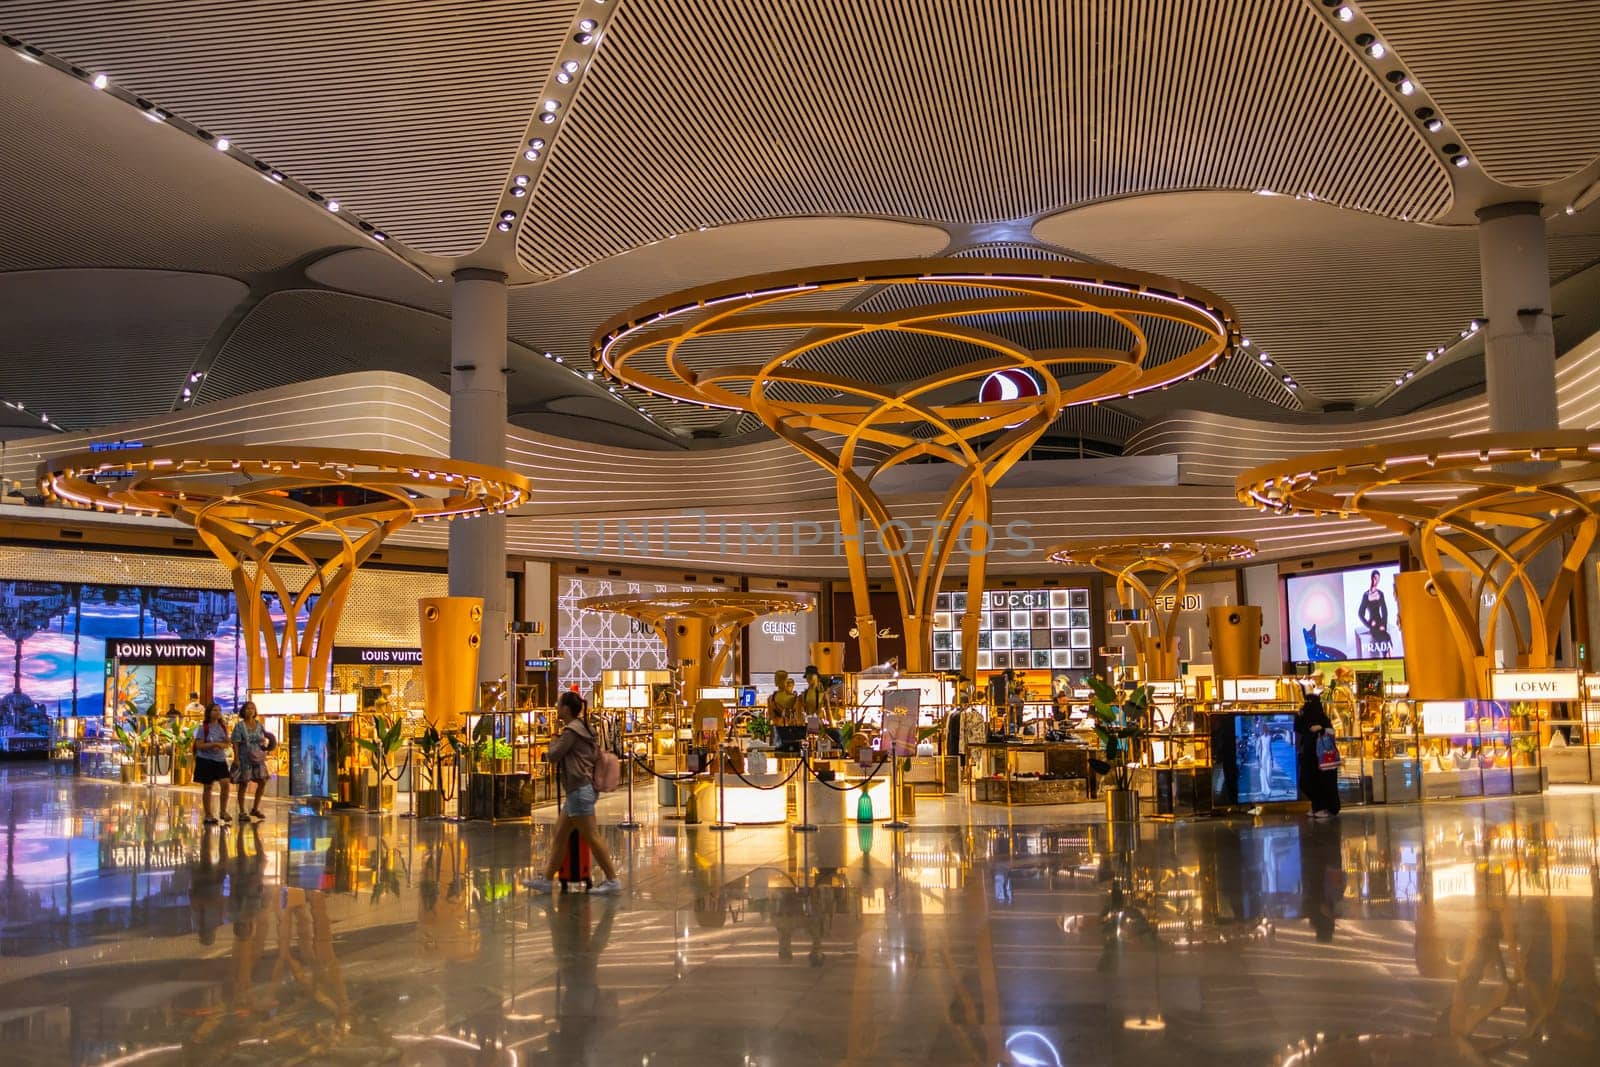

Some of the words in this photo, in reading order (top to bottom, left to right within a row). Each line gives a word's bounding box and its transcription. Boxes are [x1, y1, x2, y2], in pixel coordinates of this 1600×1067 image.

[762, 621, 798, 634] CELINE
[116, 643, 152, 656] LOUIS
[155, 644, 206, 657] VUITTON
[361, 651, 390, 661] LOUIS
[391, 651, 423, 661] VUITTO
[1515, 681, 1559, 693] LOEWE
